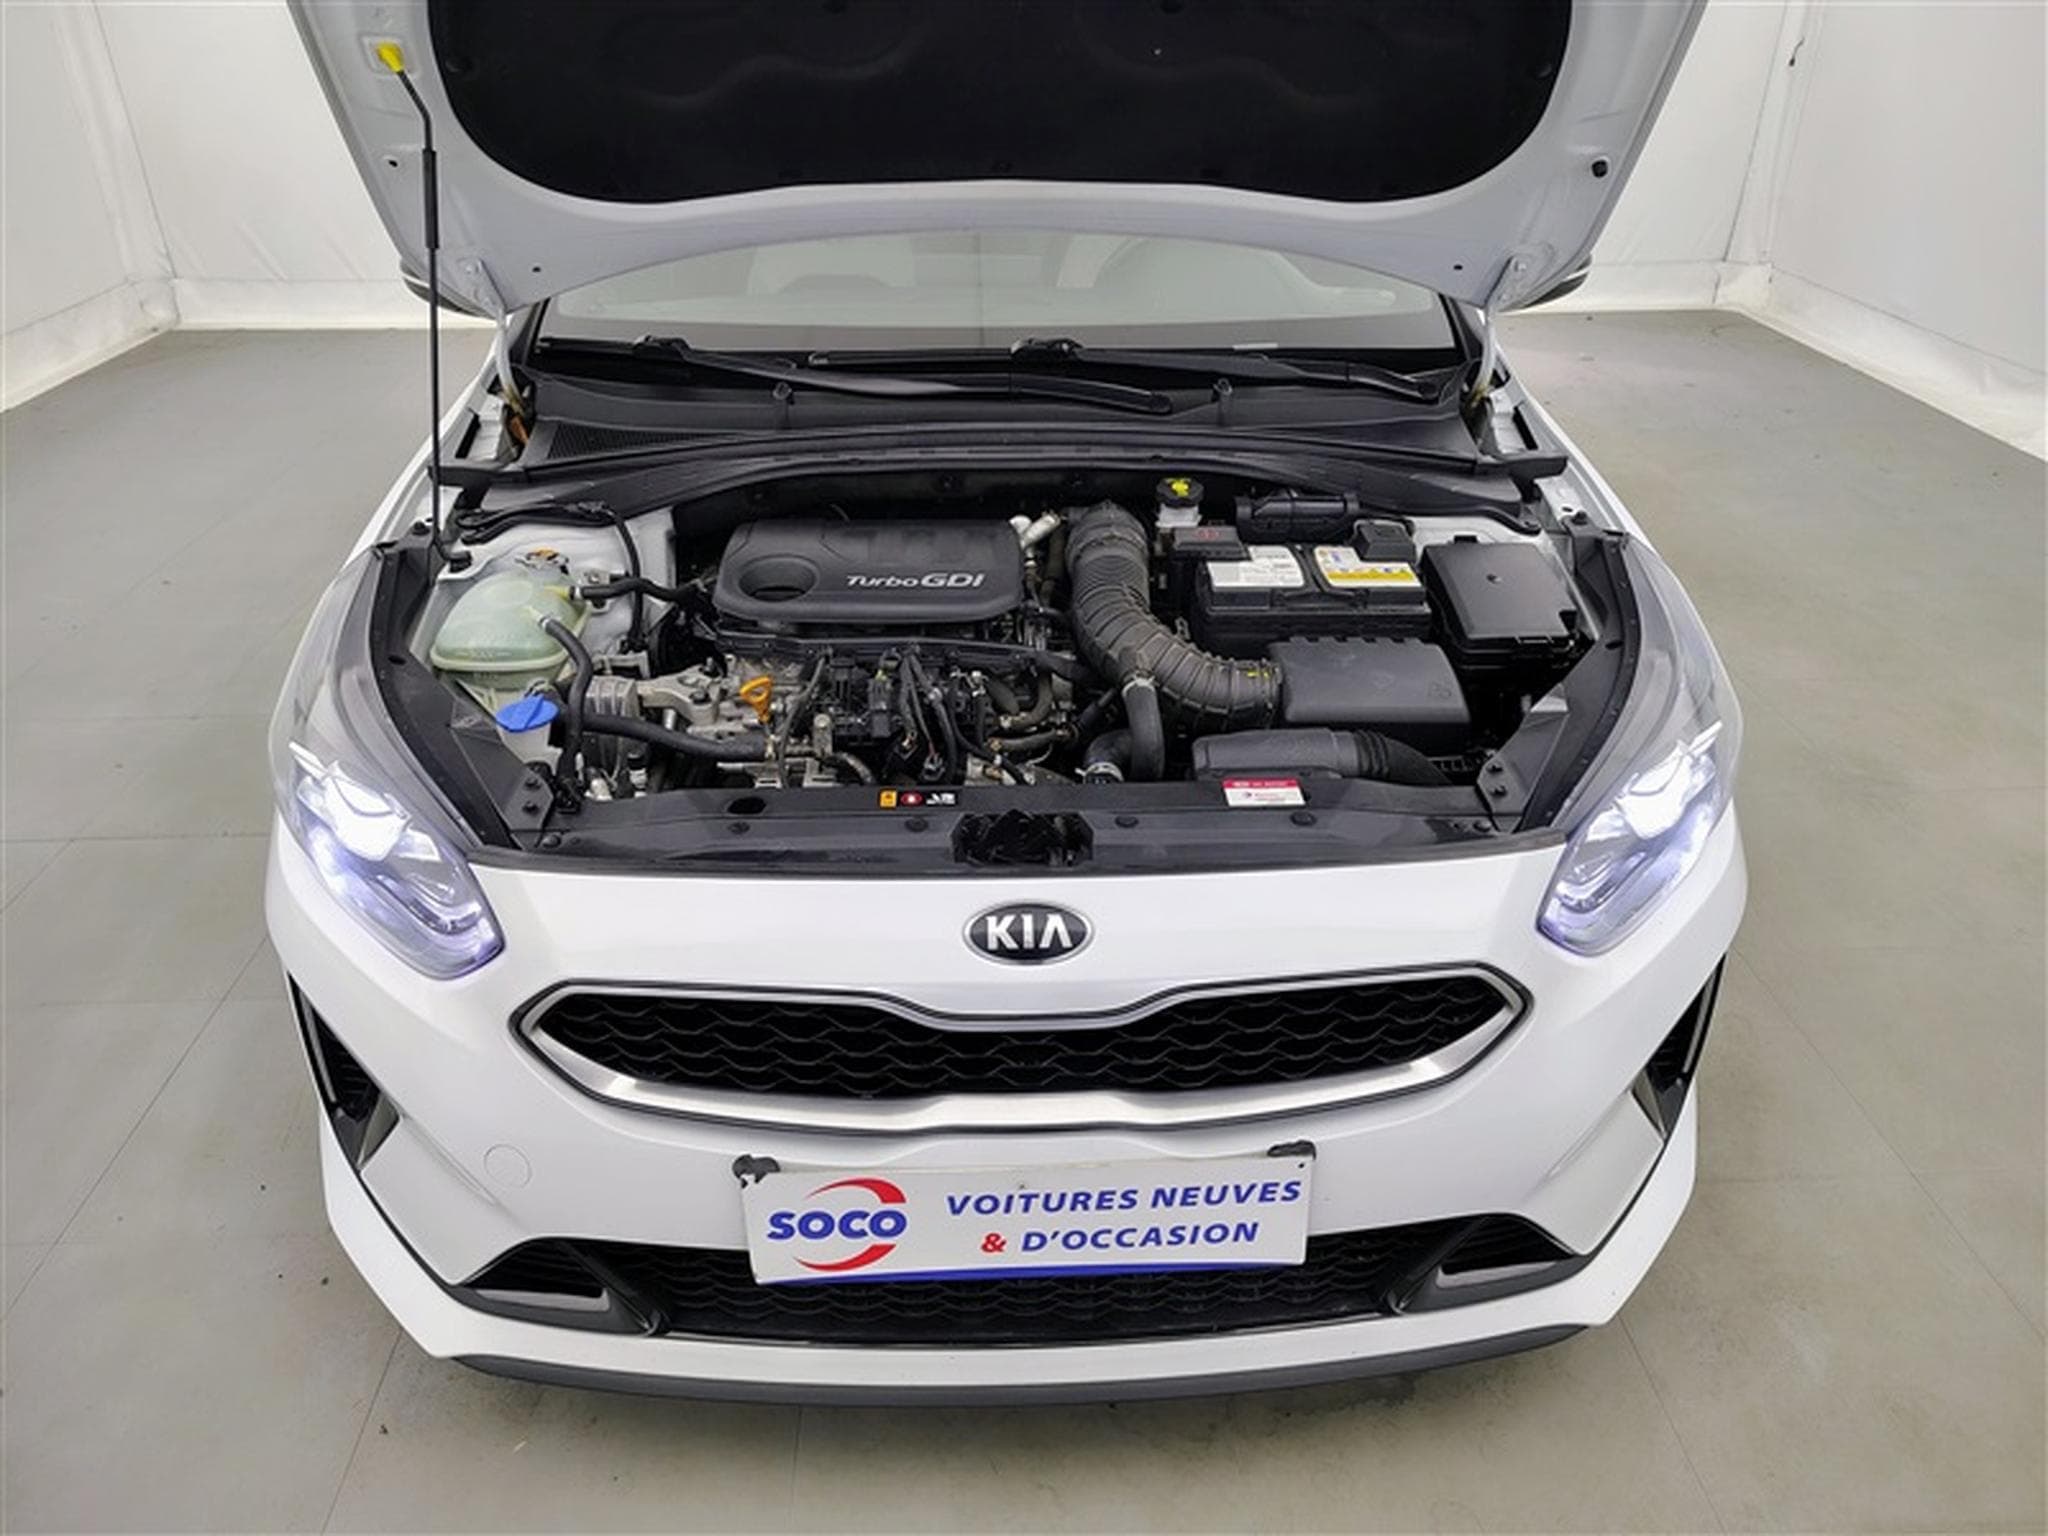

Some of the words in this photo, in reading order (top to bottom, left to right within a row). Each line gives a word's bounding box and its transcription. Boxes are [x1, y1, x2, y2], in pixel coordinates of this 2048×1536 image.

[985, 913, 1073, 950] KIA
[946, 1189, 1139, 1216] VOITURES
[1151, 1180, 1302, 1209] NEUVES
[767, 1209, 908, 1240] SOCO
[980, 1232, 1008, 1253] &
[1021, 1222, 1259, 1252] D'OCCASION
